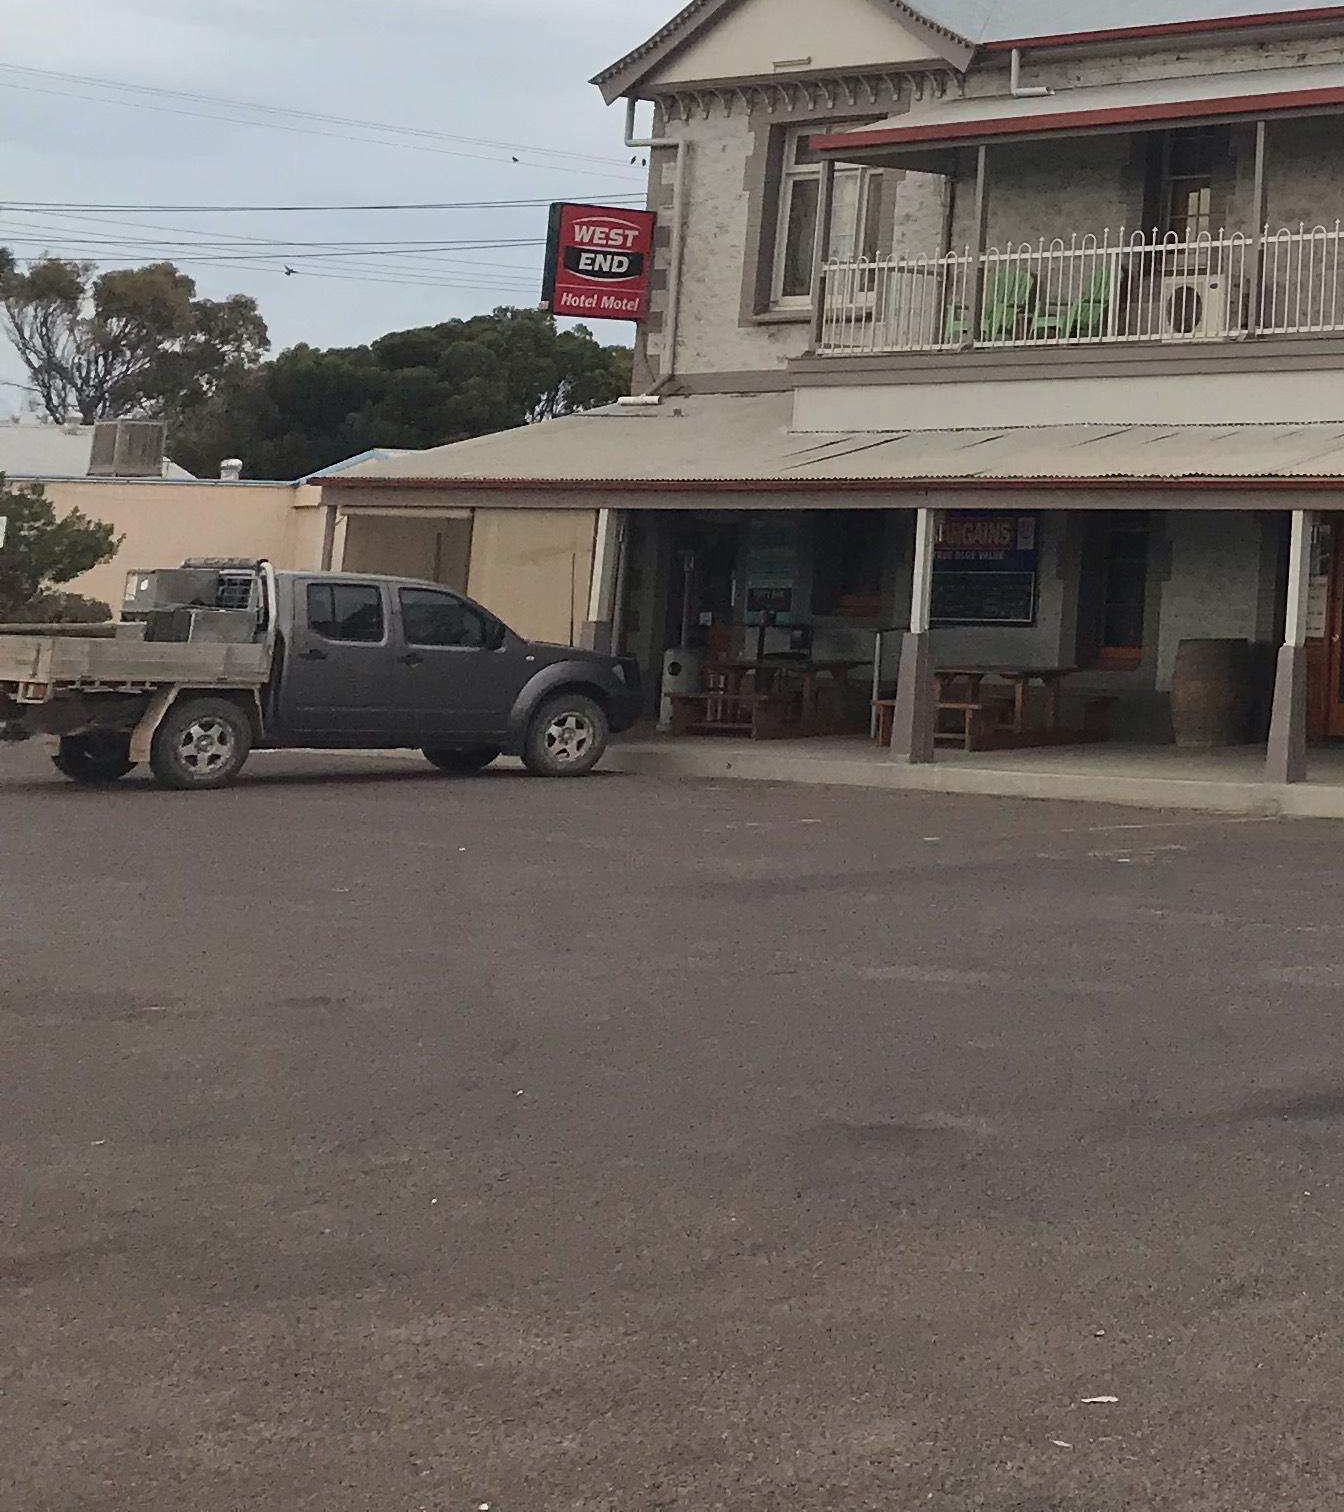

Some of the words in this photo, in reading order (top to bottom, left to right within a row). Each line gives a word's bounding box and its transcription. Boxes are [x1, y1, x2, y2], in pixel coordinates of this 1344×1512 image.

[574, 224, 640, 248] WEST
[578, 252, 631, 273] END
[560, 292, 598, 308] Hotel
[600, 294, 640, 312] Motel
